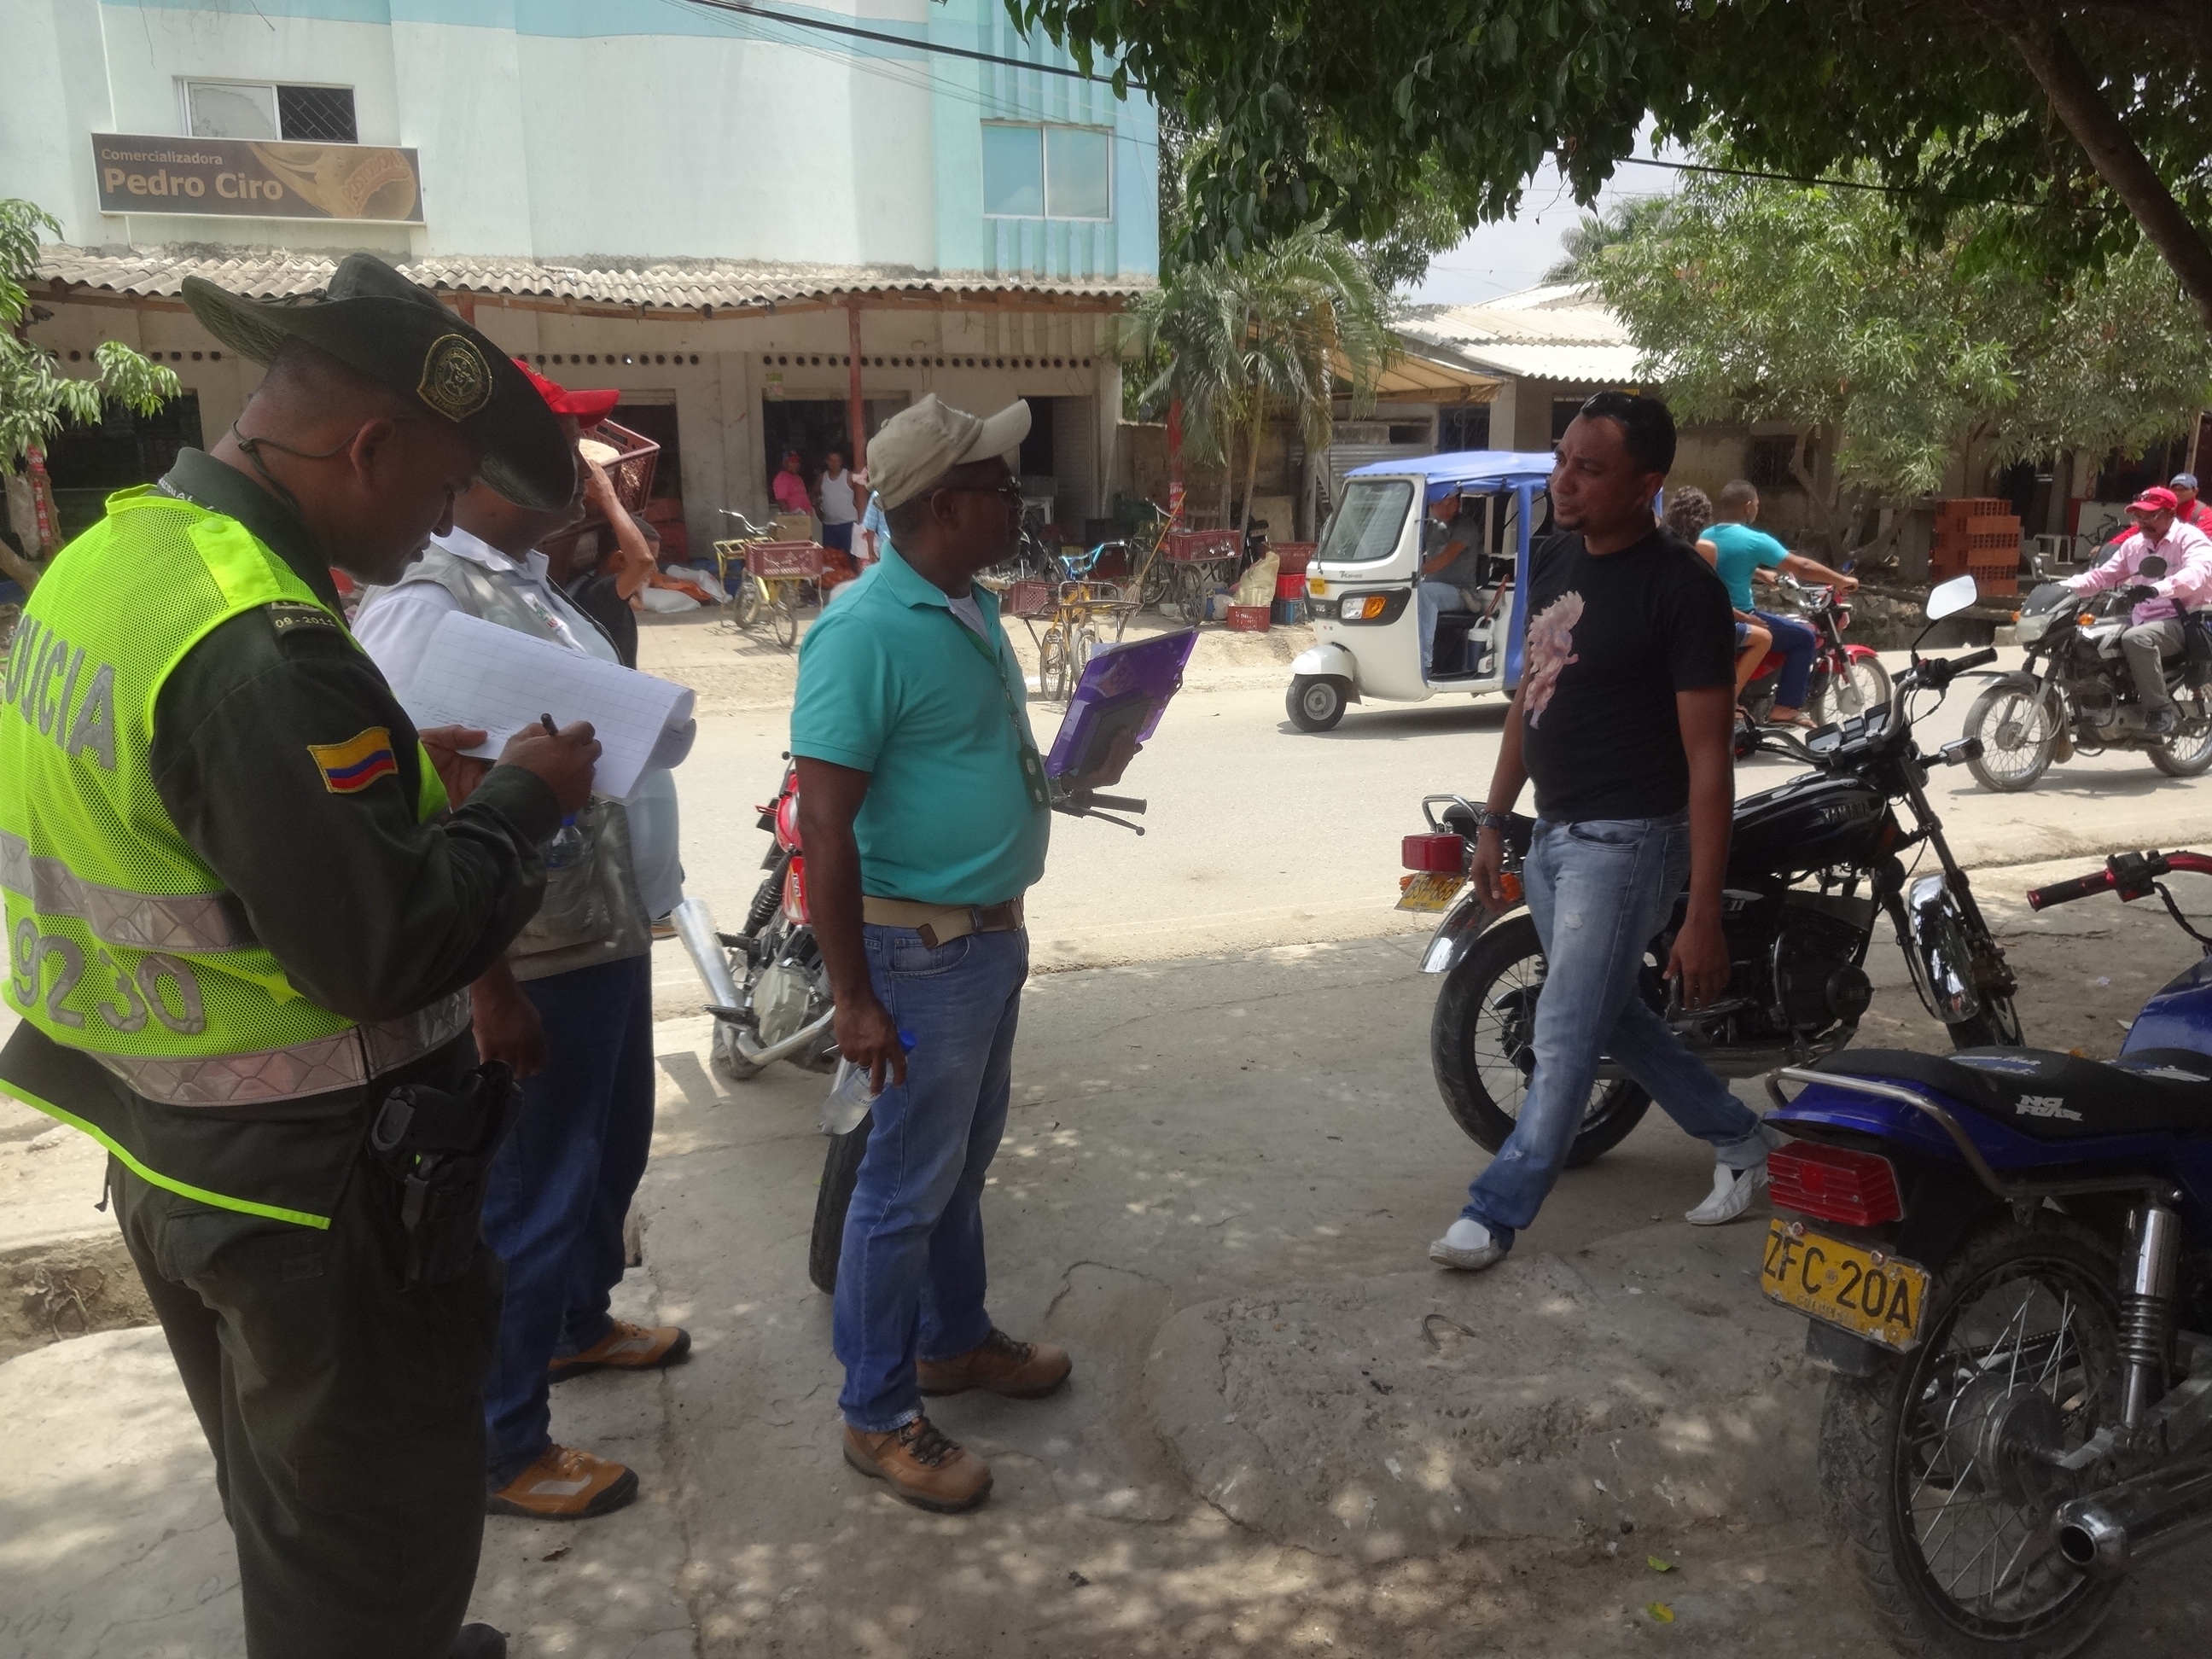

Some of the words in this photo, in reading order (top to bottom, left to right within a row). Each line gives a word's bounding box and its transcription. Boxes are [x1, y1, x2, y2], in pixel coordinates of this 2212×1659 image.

[101, 148, 224, 166] Comercializadora
[103, 167, 206, 198] Pedro
[215, 172, 283, 201] Ciro
[5, 614, 118, 772] OLICIA
[2014, 1103, 2084, 1122] FEAR
[2019, 1094, 2064, 1109] NO
[1764, 1229, 1825, 1295] ZFC
[1836, 1260, 1912, 1330] 20A
